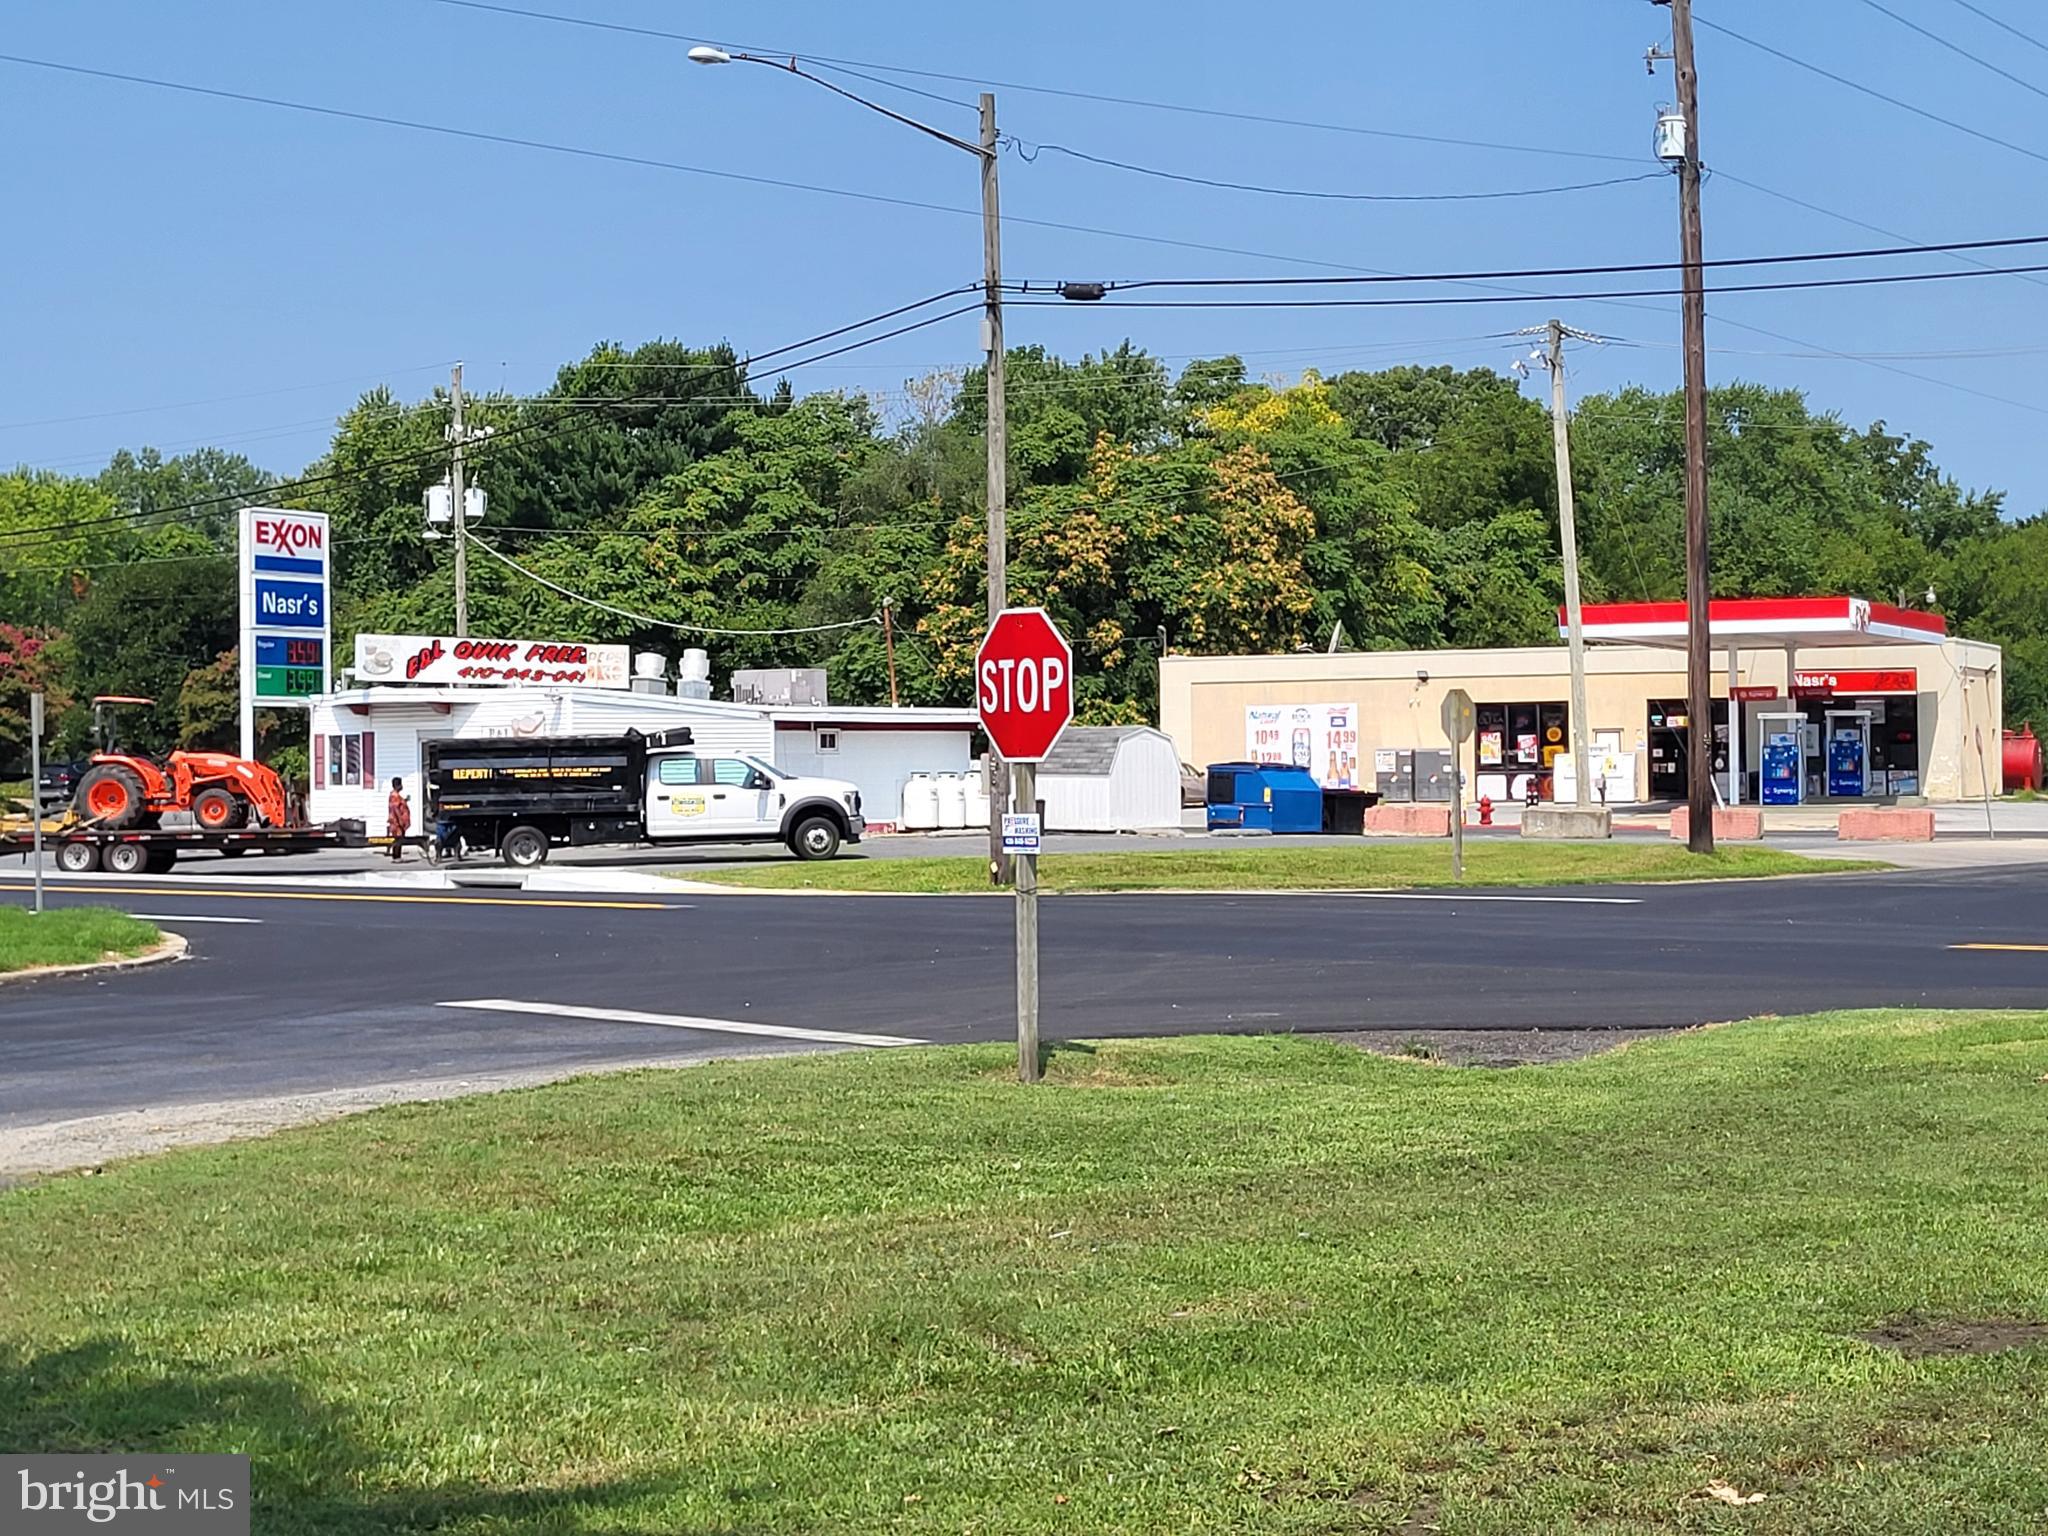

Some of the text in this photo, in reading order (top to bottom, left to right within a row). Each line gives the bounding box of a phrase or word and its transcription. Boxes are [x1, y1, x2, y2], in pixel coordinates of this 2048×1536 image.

[256, 519, 321, 556] EXXON
[262, 591, 318, 616] Nasr's
[453, 641, 518, 662] QUIK
[981, 657, 1064, 714] STOP
[1794, 673, 1838, 687] Nasr's
